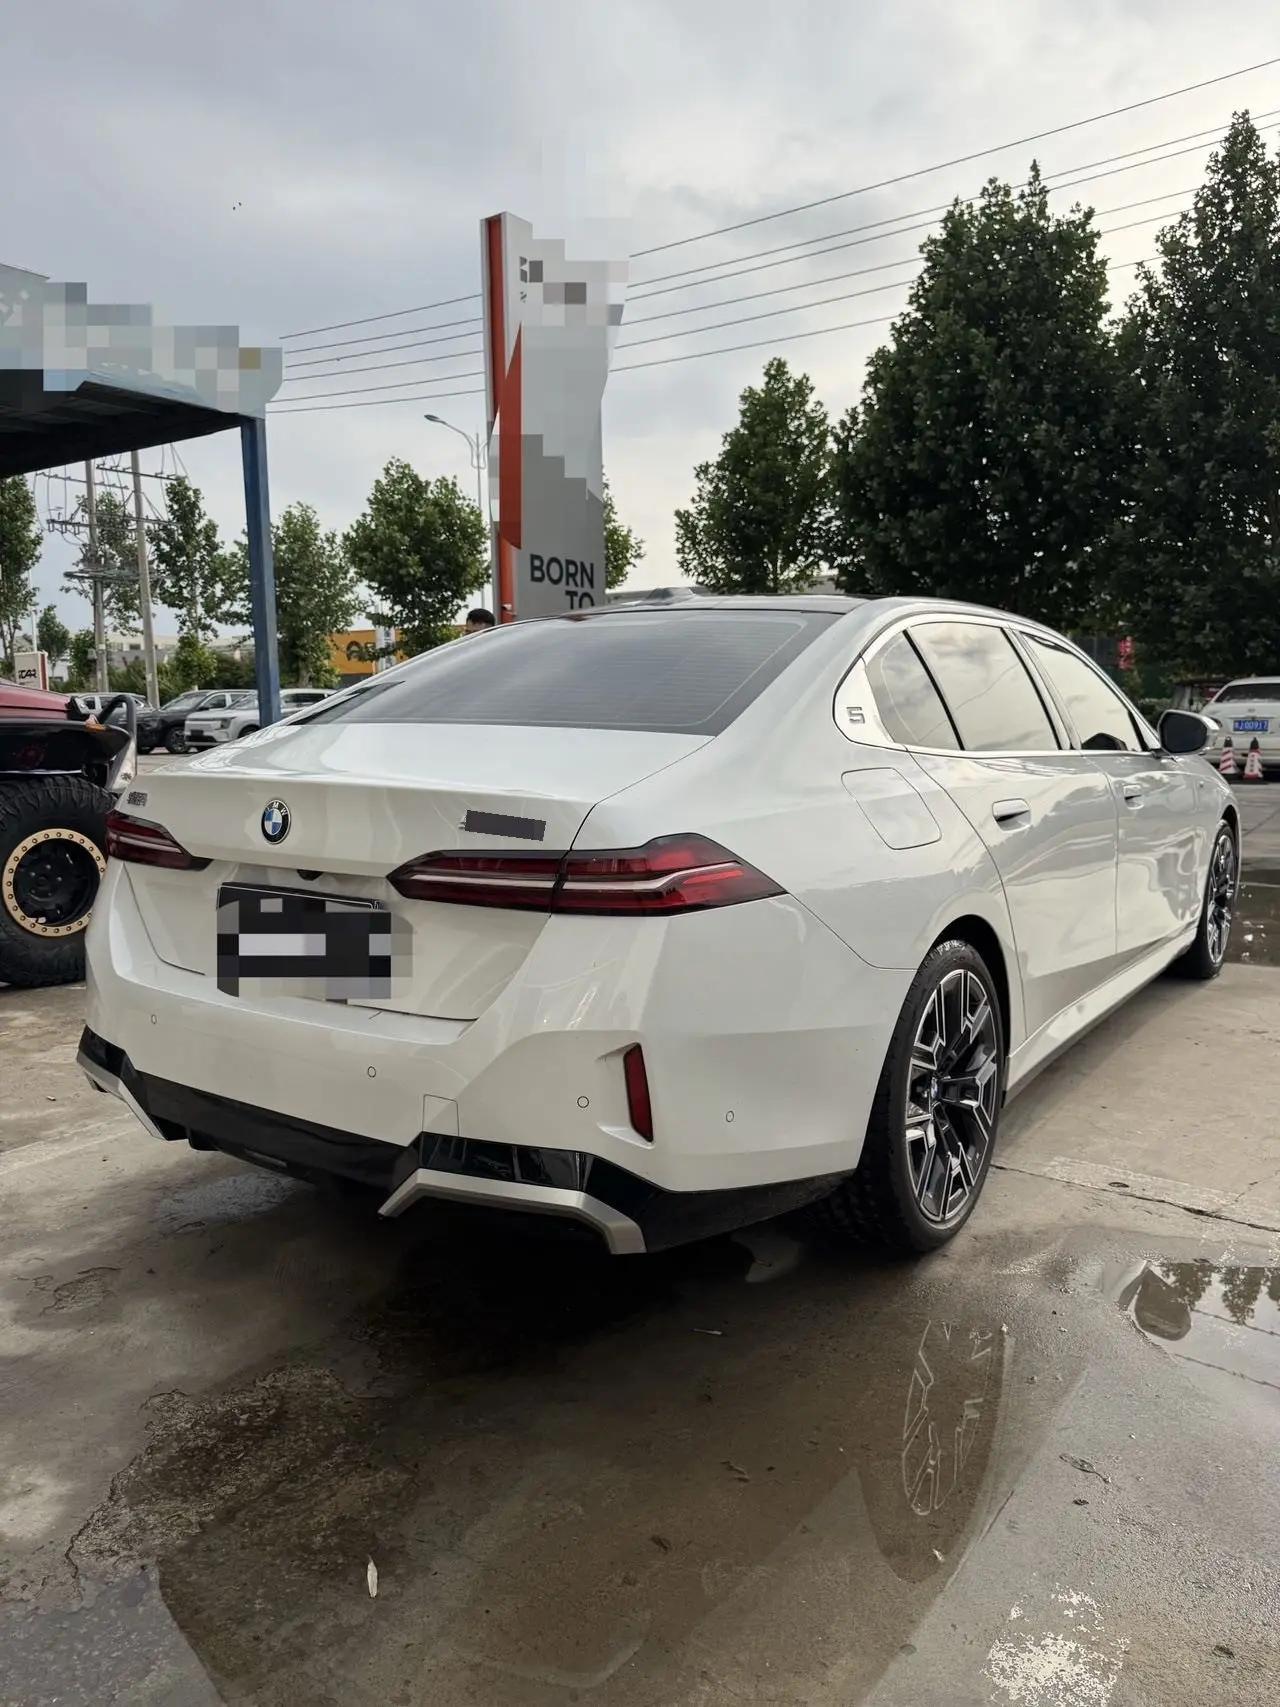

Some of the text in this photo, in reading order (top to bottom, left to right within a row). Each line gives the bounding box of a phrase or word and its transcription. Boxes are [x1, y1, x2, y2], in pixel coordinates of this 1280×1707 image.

[529, 553, 595, 590] BORN
[564, 590, 596, 611] TO
[846, 706, 866, 725] 5
